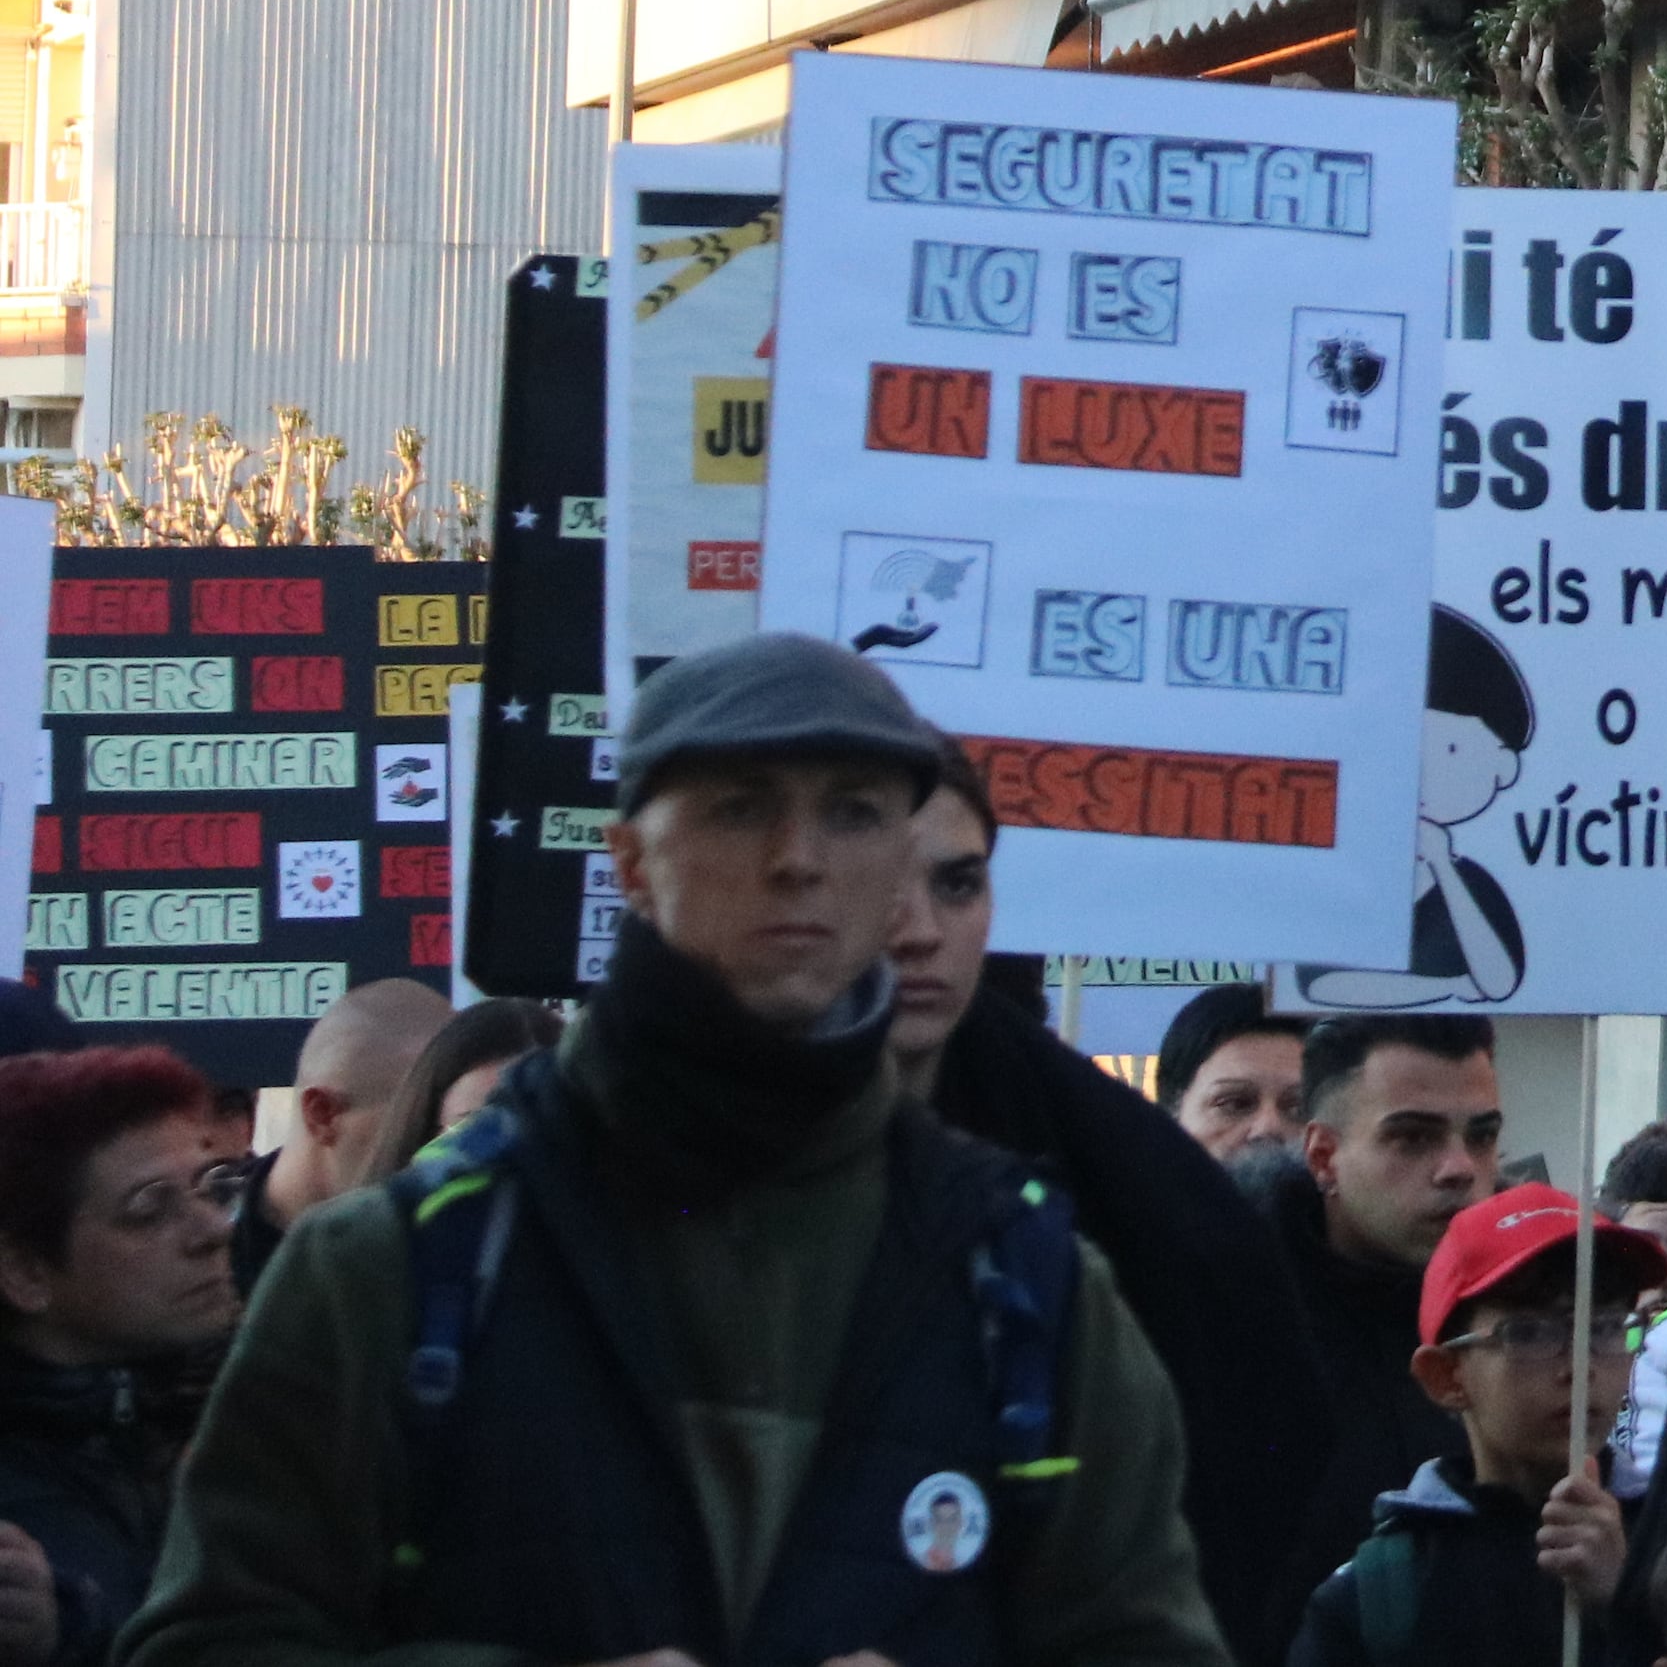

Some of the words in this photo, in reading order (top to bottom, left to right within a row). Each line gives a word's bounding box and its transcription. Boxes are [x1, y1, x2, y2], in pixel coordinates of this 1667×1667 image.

[880, 117, 1367, 226] SEGURETAT
[914, 240, 1031, 326] NO
[1446, 230, 1492, 340] i
[1522, 228, 1635, 344] té
[874, 369, 987, 454] UN
[1030, 381, 1243, 474] LUXE
[195, 580, 315, 632] UNS
[1490, 539, 1590, 624] els
[387, 597, 451, 643] LA
[1176, 600, 1340, 688] UNA
[257, 657, 339, 709] ON
[1597, 688, 1637, 745] o
[90, 737, 350, 787] CAMINAR
[87, 816, 243, 870] SIGUI
[109, 893, 255, 943] ACTE
[62, 967, 344, 1017] VALENTIA
